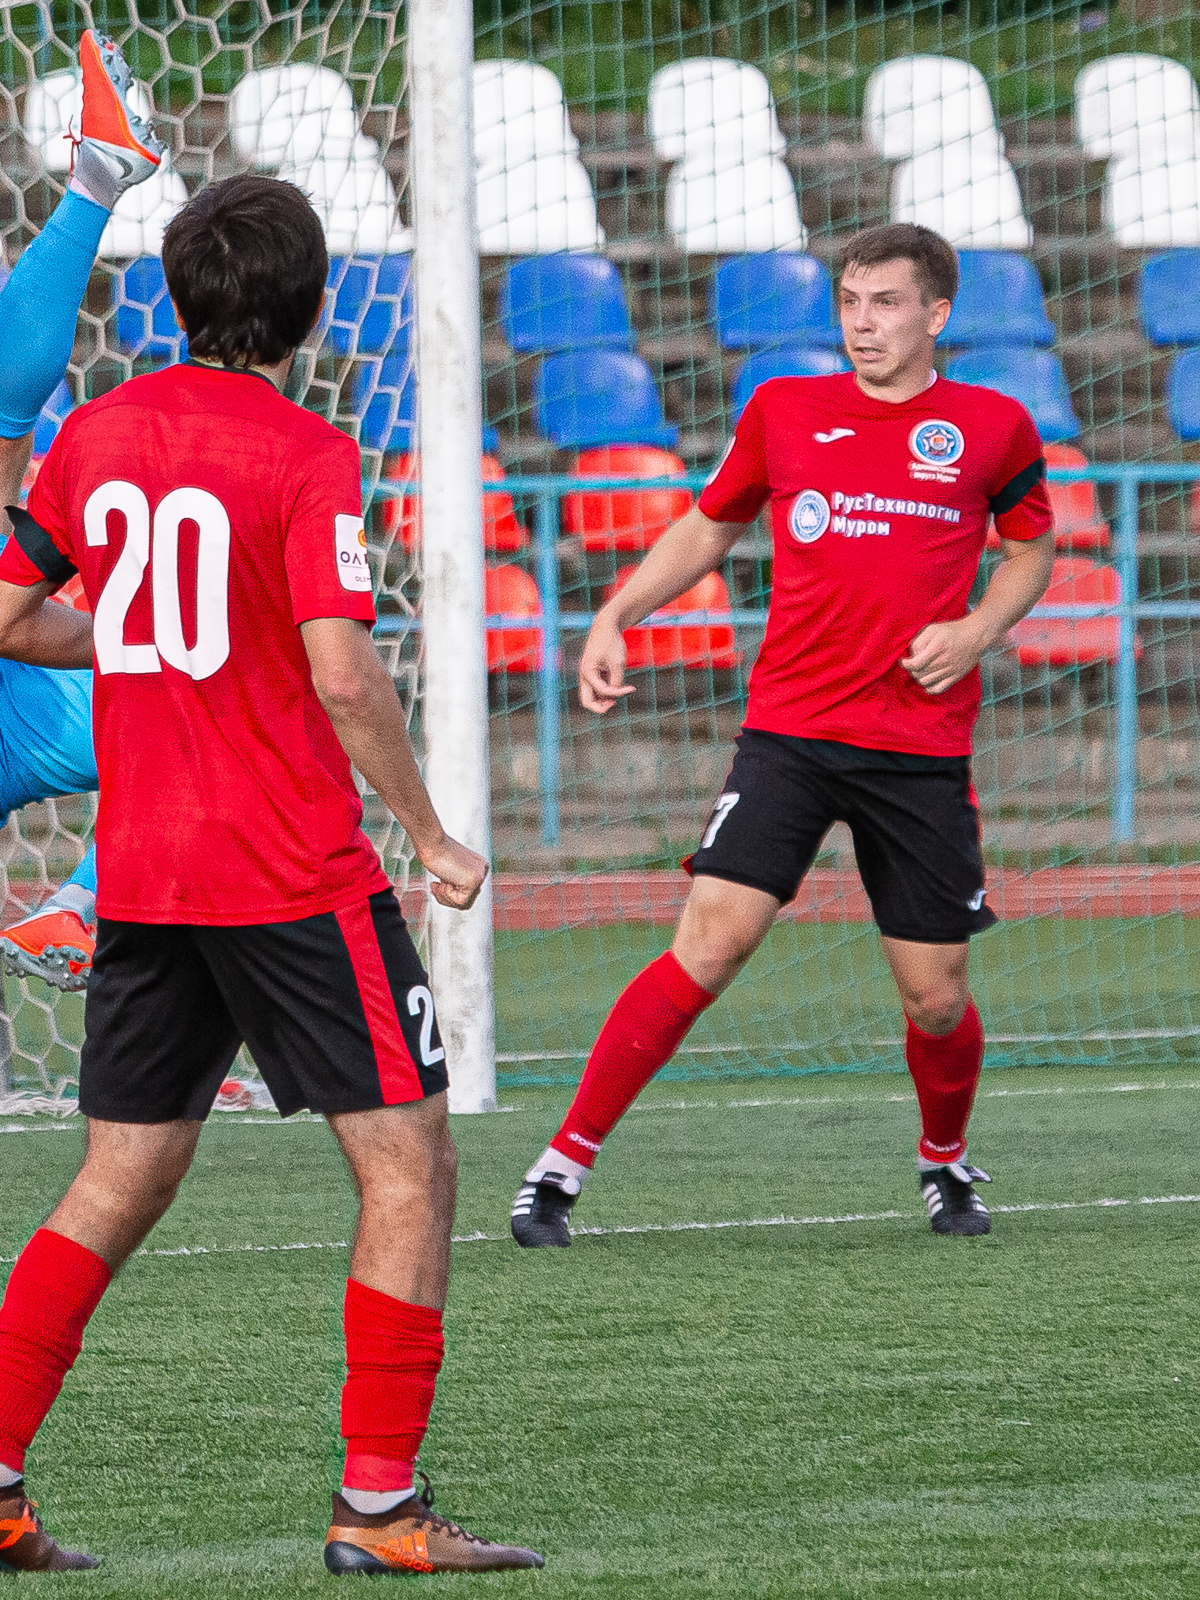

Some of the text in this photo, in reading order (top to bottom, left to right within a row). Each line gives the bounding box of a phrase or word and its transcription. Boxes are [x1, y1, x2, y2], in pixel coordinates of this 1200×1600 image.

[833, 491, 961, 523] РусТехнологии
[833, 515, 891, 538] Муром
[83, 480, 231, 680] 20
[700, 791, 741, 849] 7
